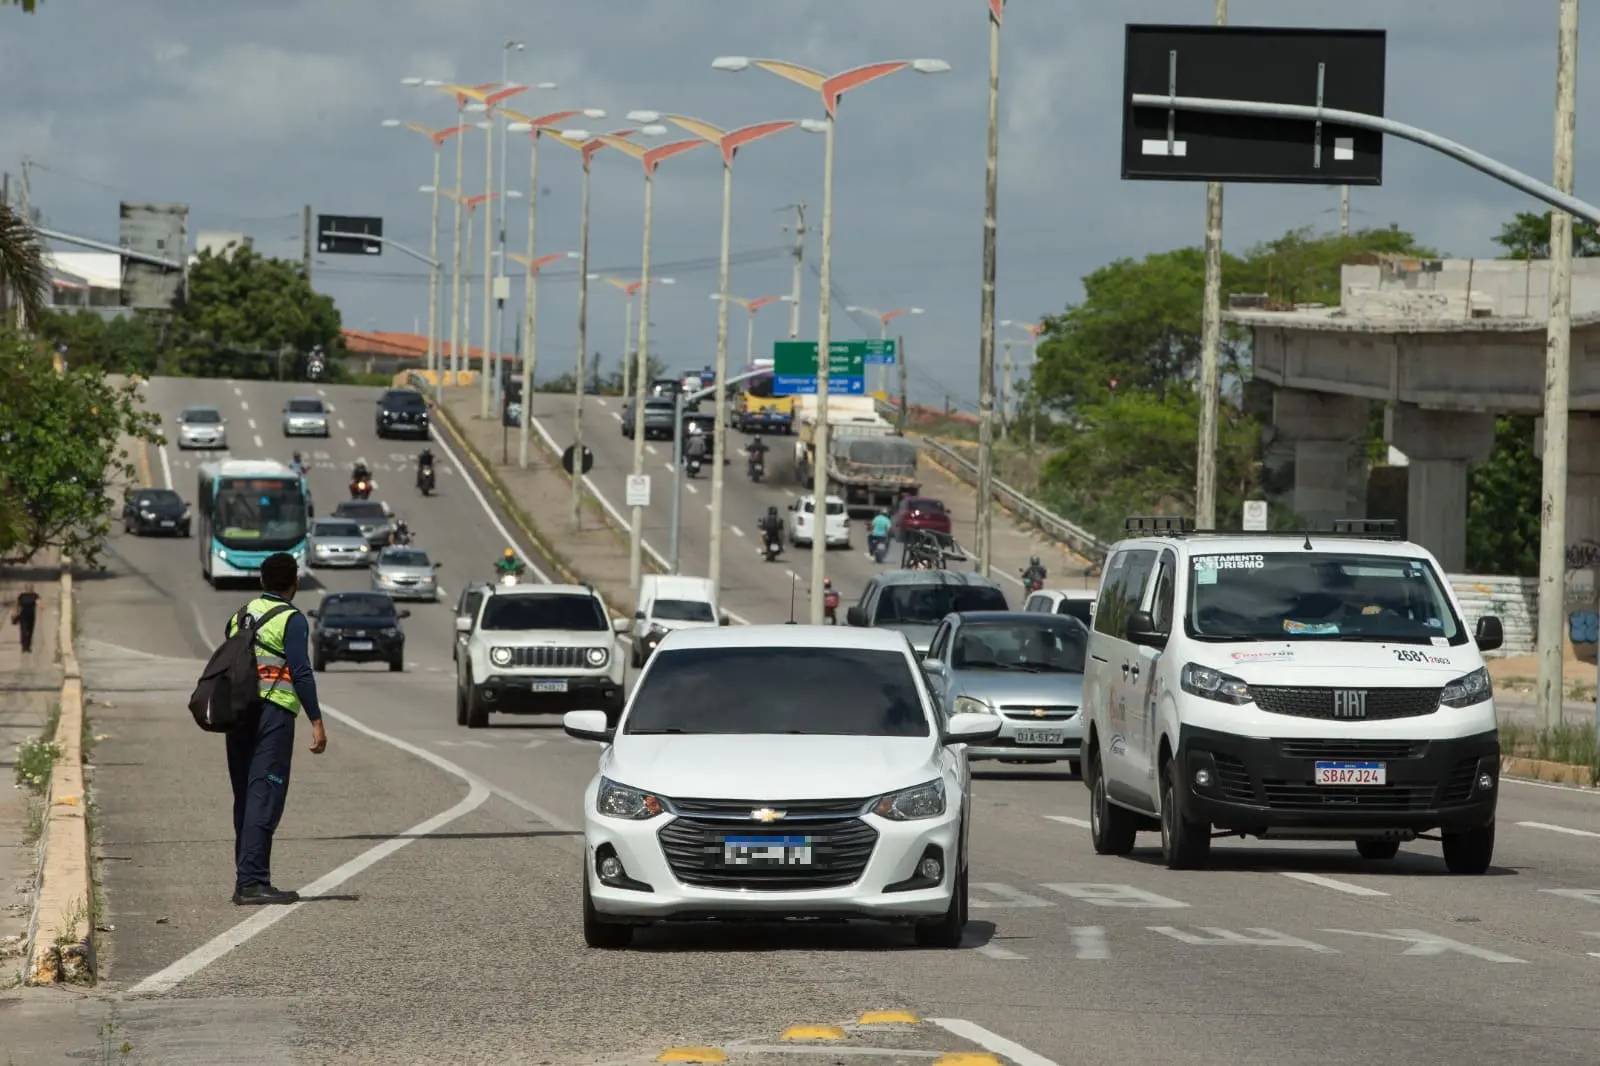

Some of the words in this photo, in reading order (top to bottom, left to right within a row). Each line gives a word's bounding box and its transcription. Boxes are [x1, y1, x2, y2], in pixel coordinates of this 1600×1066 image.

[1193, 555, 1264, 564] FRETAMENTO
[1393, 649, 1429, 663] 2681
[1334, 689, 1368, 717] FIAT
[1323, 769, 1379, 783] SBA7J24
